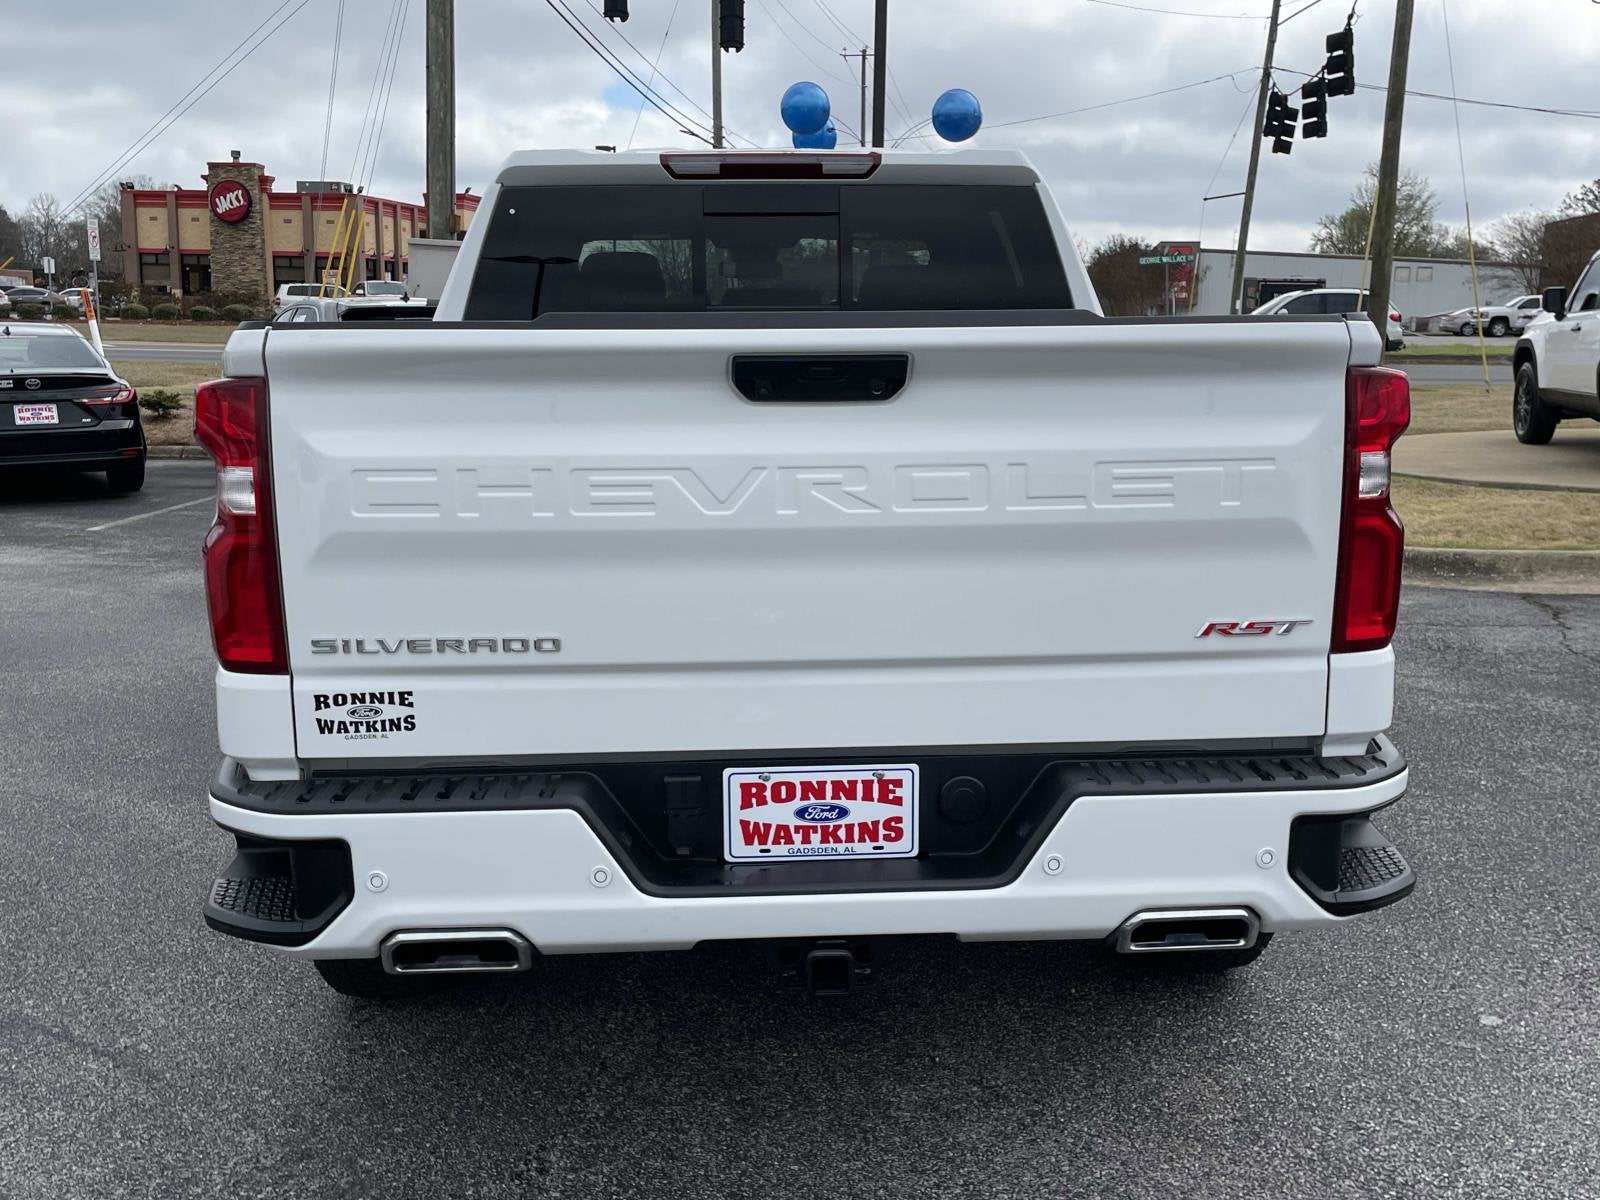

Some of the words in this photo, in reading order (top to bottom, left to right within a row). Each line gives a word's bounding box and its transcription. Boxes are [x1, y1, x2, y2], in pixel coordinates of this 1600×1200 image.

[1139, 256, 1161, 265] GEORGE
[1162, 255, 1187, 263] WALLACE
[17, 406, 54, 414] RONNIE
[351, 457, 1277, 519] CHEVROLET
[1194, 620, 1314, 638] RST
[311, 637, 561, 654] SILVERADO
[313, 690, 414, 712] RONNIE
[353, 707, 377, 718] Ford
[315, 714, 416, 735] WATKINS
[739, 778, 904, 811] RONNIE
[803, 805, 840, 820] Ford
[739, 816, 904, 846] WATKINS
[787, 846, 841, 855] GADSDEN,
